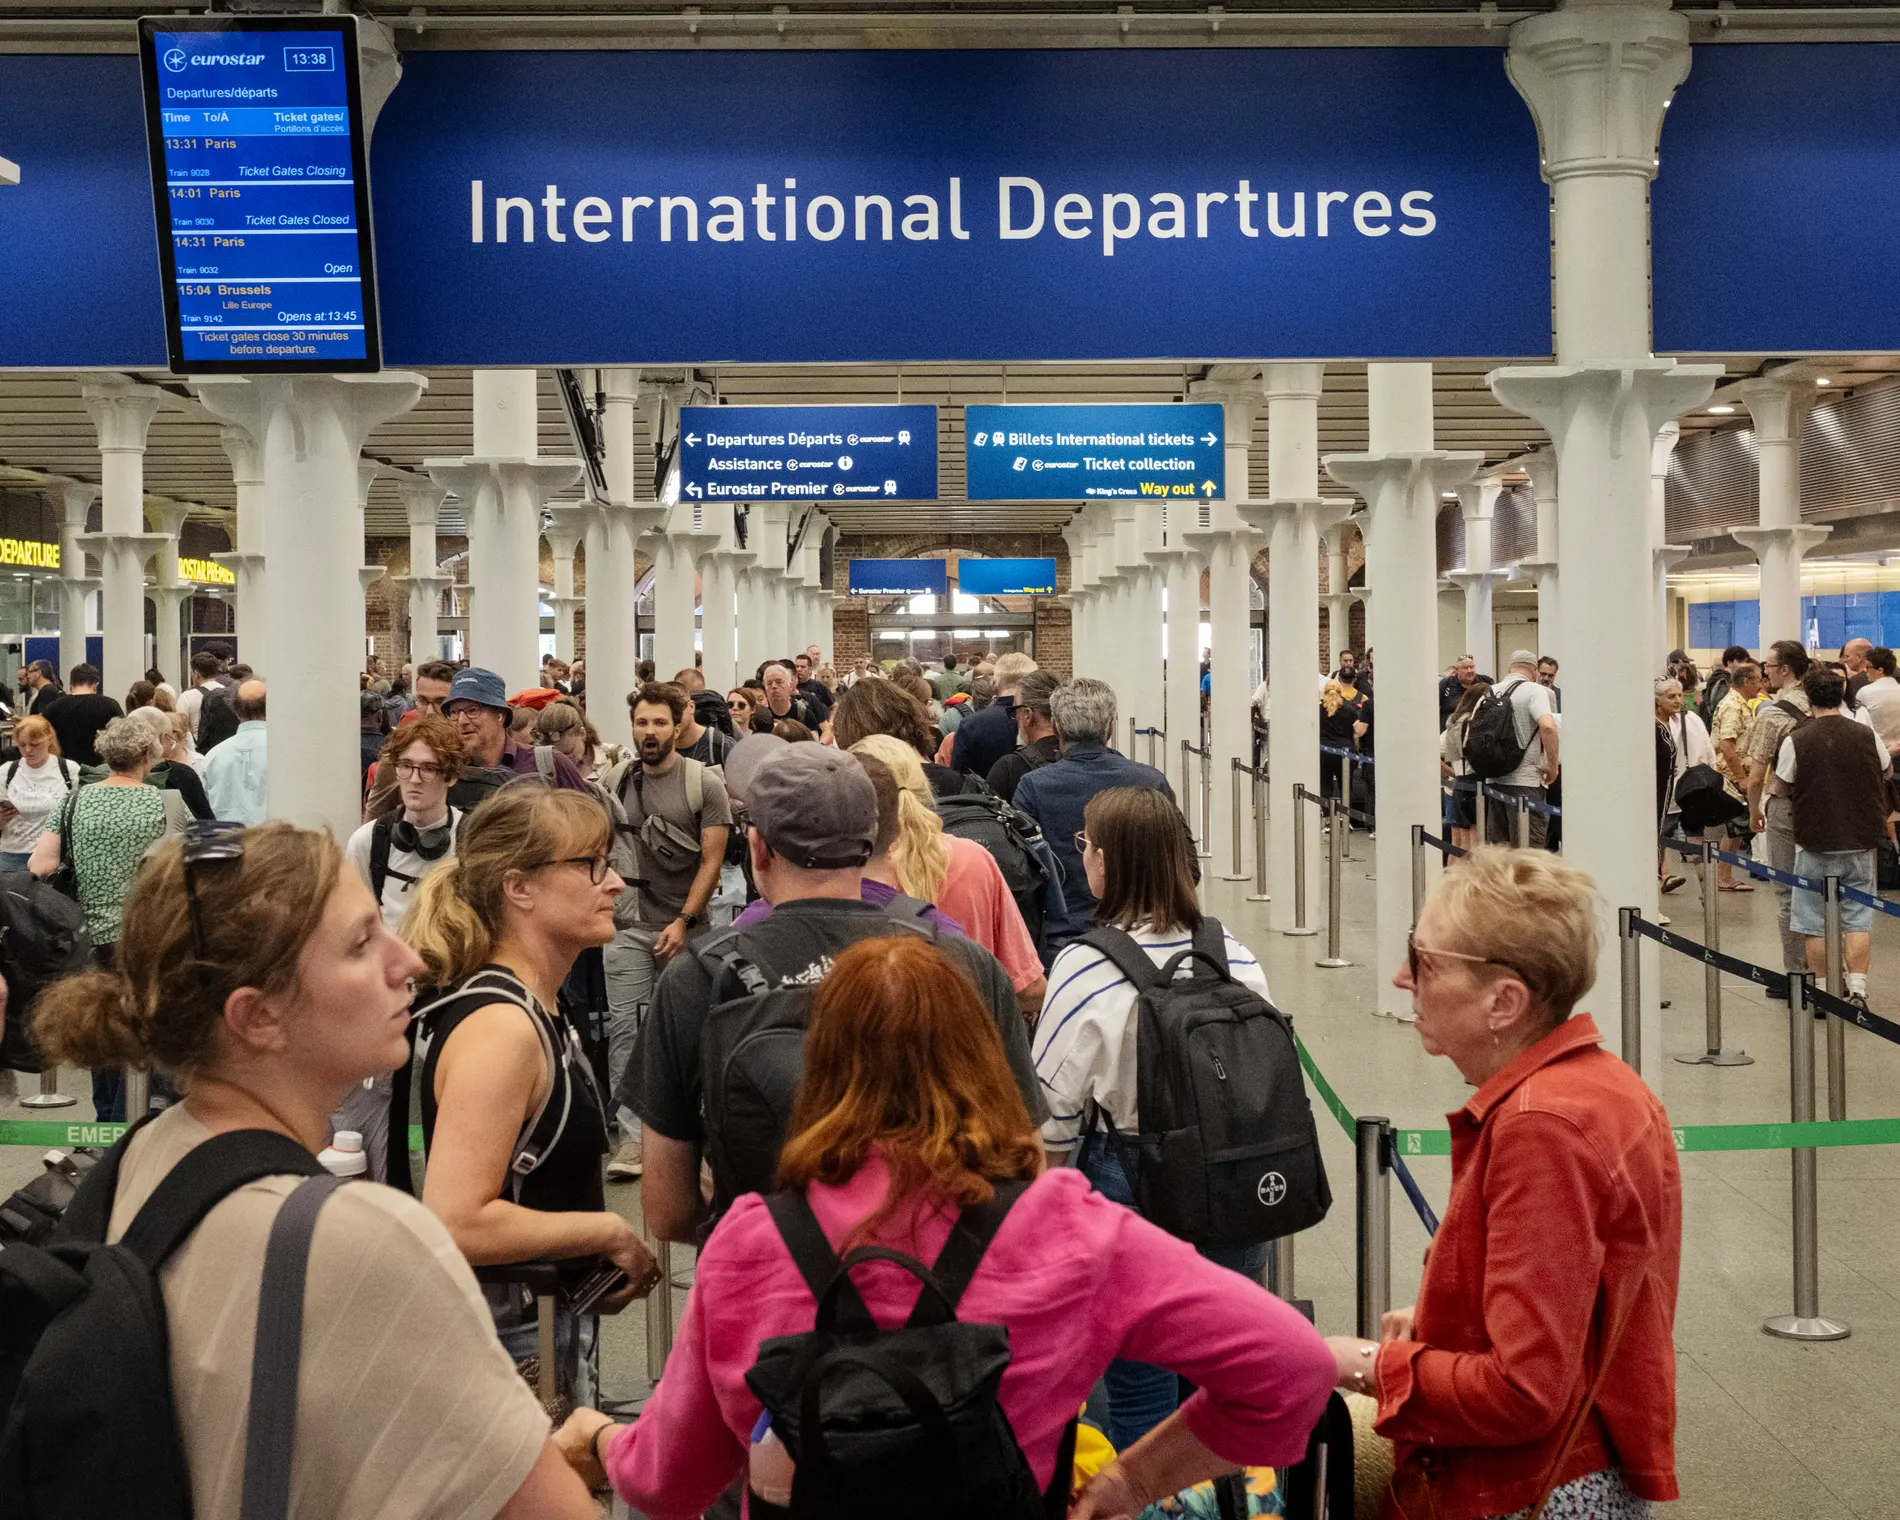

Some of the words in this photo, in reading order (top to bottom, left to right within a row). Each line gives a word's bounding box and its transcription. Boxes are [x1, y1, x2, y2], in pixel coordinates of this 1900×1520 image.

[191, 53, 265, 66] eurostar
[292, 53, 327, 65] 13:38
[167, 87, 278, 100] Departures/départs
[163, 112, 191, 123] Time
[273, 112, 308, 122] Ticket
[310, 112, 344, 124] gates/
[274, 125, 312, 133] Portillons
[313, 125, 345, 133] d'accès
[166, 139, 197, 149] 13:31
[205, 138, 237, 149] Paris
[169, 169, 188, 177] Train
[190, 169, 210, 177] 9028
[239, 166, 270, 177] Ticket
[272, 165, 303, 176] Gates
[306, 165, 346, 178] Closing
[170, 188, 201, 199] 14:01
[209, 187, 241, 199] Paris
[173, 218, 193, 226] Train
[195, 218, 214, 226] 9030
[245, 215, 276, 226] Ticket
[278, 215, 310, 225] Gates
[312, 214, 350, 225] Closed
[471, 177, 969, 243] International
[998, 176, 1437, 256] Departures
[174, 237, 206, 248] 14:31
[213, 236, 245, 248] Paris
[178, 266, 197, 274] Train
[199, 266, 219, 274] 9032
[324, 263, 353, 275] Open
[178, 285, 211, 296] 15:04
[218, 284, 271, 296] Brussels
[222, 301, 239, 310] Lille
[241, 301, 272, 311] Europe
[182, 315, 202, 323] Train
[203, 315, 223, 323] 9142
[277, 311, 312, 323] Opens
[314, 311, 357, 322] at:13:45
[198, 332, 229, 342] Ticket
[231, 332, 260, 344] gates
[262, 331, 289, 342] close
[292, 331, 306, 341] 30
[308, 331, 349, 341] minutes
[229, 344, 263, 355] before
[265, 343, 318, 355] departure.
[707, 433, 785, 448] Departures
[788, 432, 843, 448] Départs
[859, 435, 894, 443] eurostar
[1009, 433, 1053, 446] Billets
[1056, 433, 1145, 446] International
[1148, 432, 1195, 446] tickets
[708, 458, 783, 471] Assistance
[1044, 461, 1079, 469] eurostar
[1083, 457, 1126, 471] Ticket
[1129, 457, 1195, 471] collection
[707, 482, 768, 495] Eurostar
[771, 482, 828, 495] Premier
[845, 485, 880, 493] eurostar
[1097, 488, 1117, 496] King's
[1140, 482, 1169, 497] Way
[1172, 483, 1195, 495] out
[1260, 1184, 1284, 1193] BAYER
